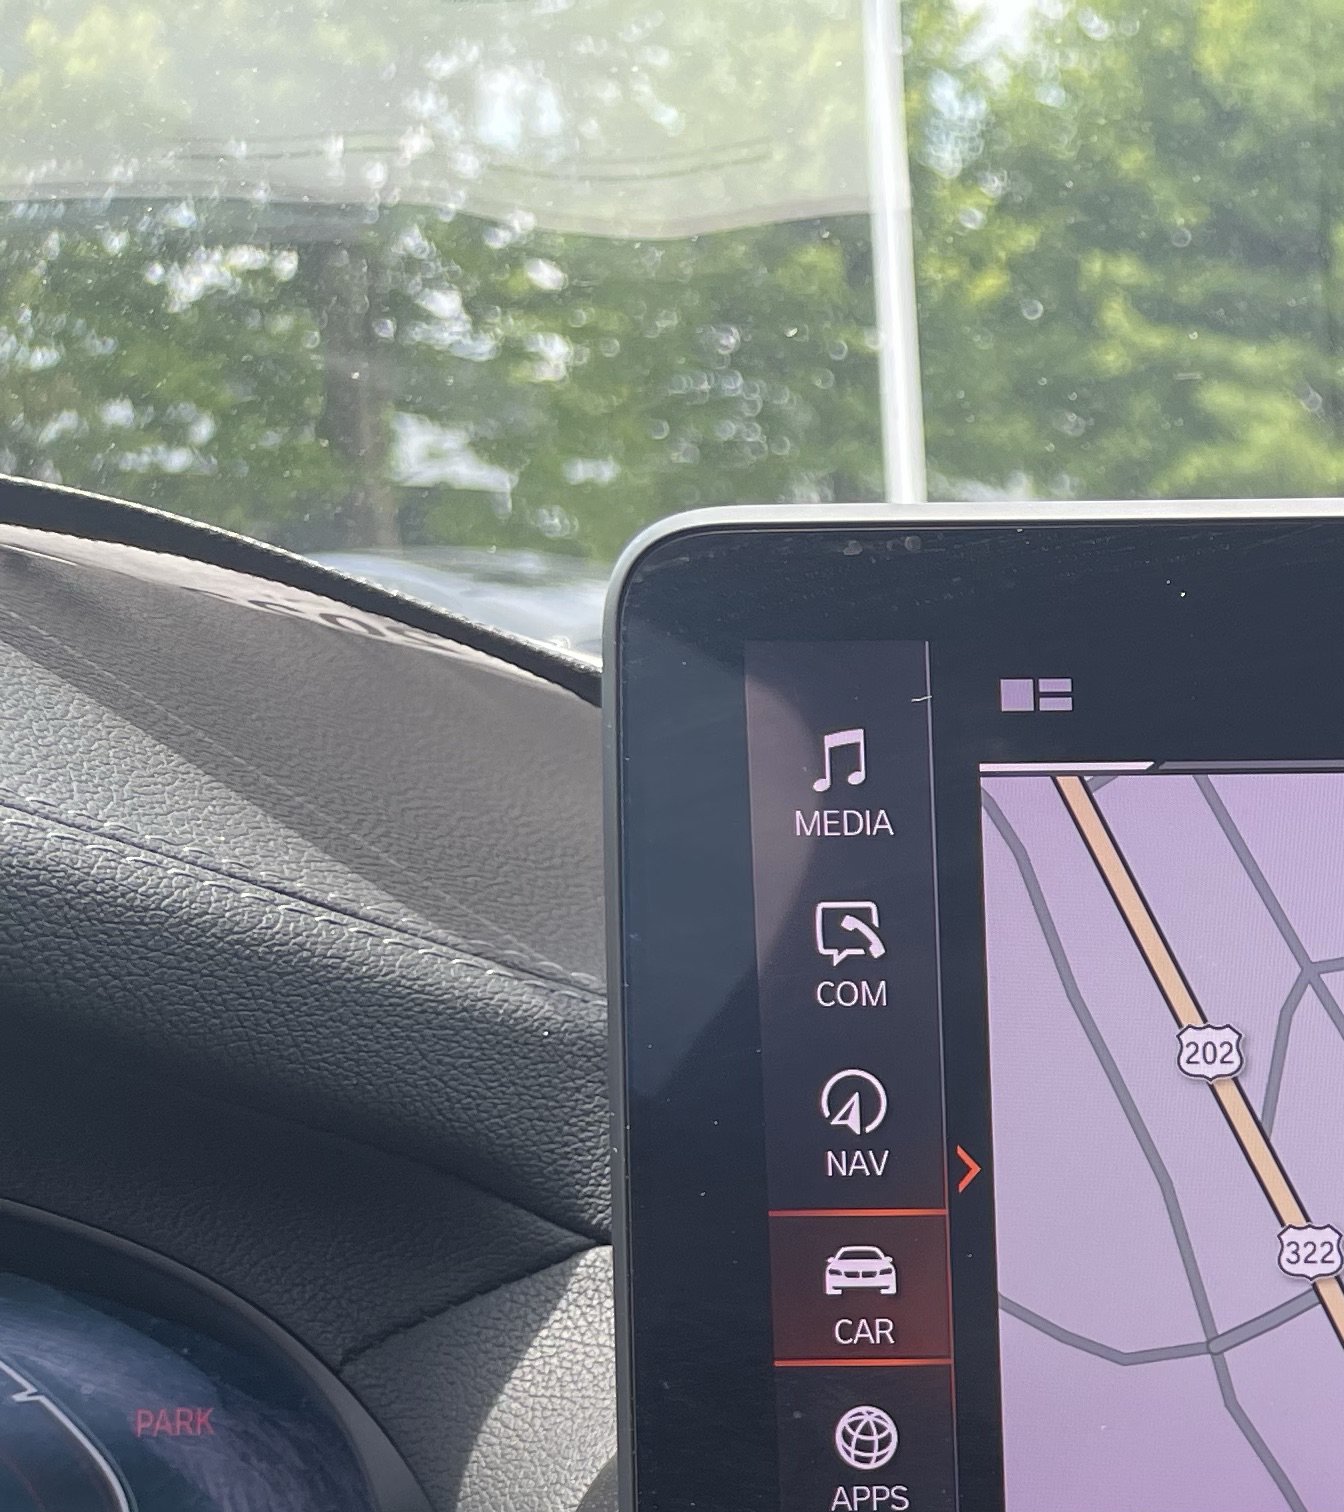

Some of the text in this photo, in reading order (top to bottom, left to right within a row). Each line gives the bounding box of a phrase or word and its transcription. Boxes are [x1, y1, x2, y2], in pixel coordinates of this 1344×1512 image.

[795, 809, 895, 837] MEDIA
[816, 980, 887, 1007] COM
[1183, 1041, 1236, 1067] 202
[827, 1150, 889, 1177] NAV
[1283, 1239, 1337, 1267] 322
[834, 1318, 895, 1345] CAR
[133, 1405, 216, 1439] PARK
[831, 1485, 910, 1512] APPS
